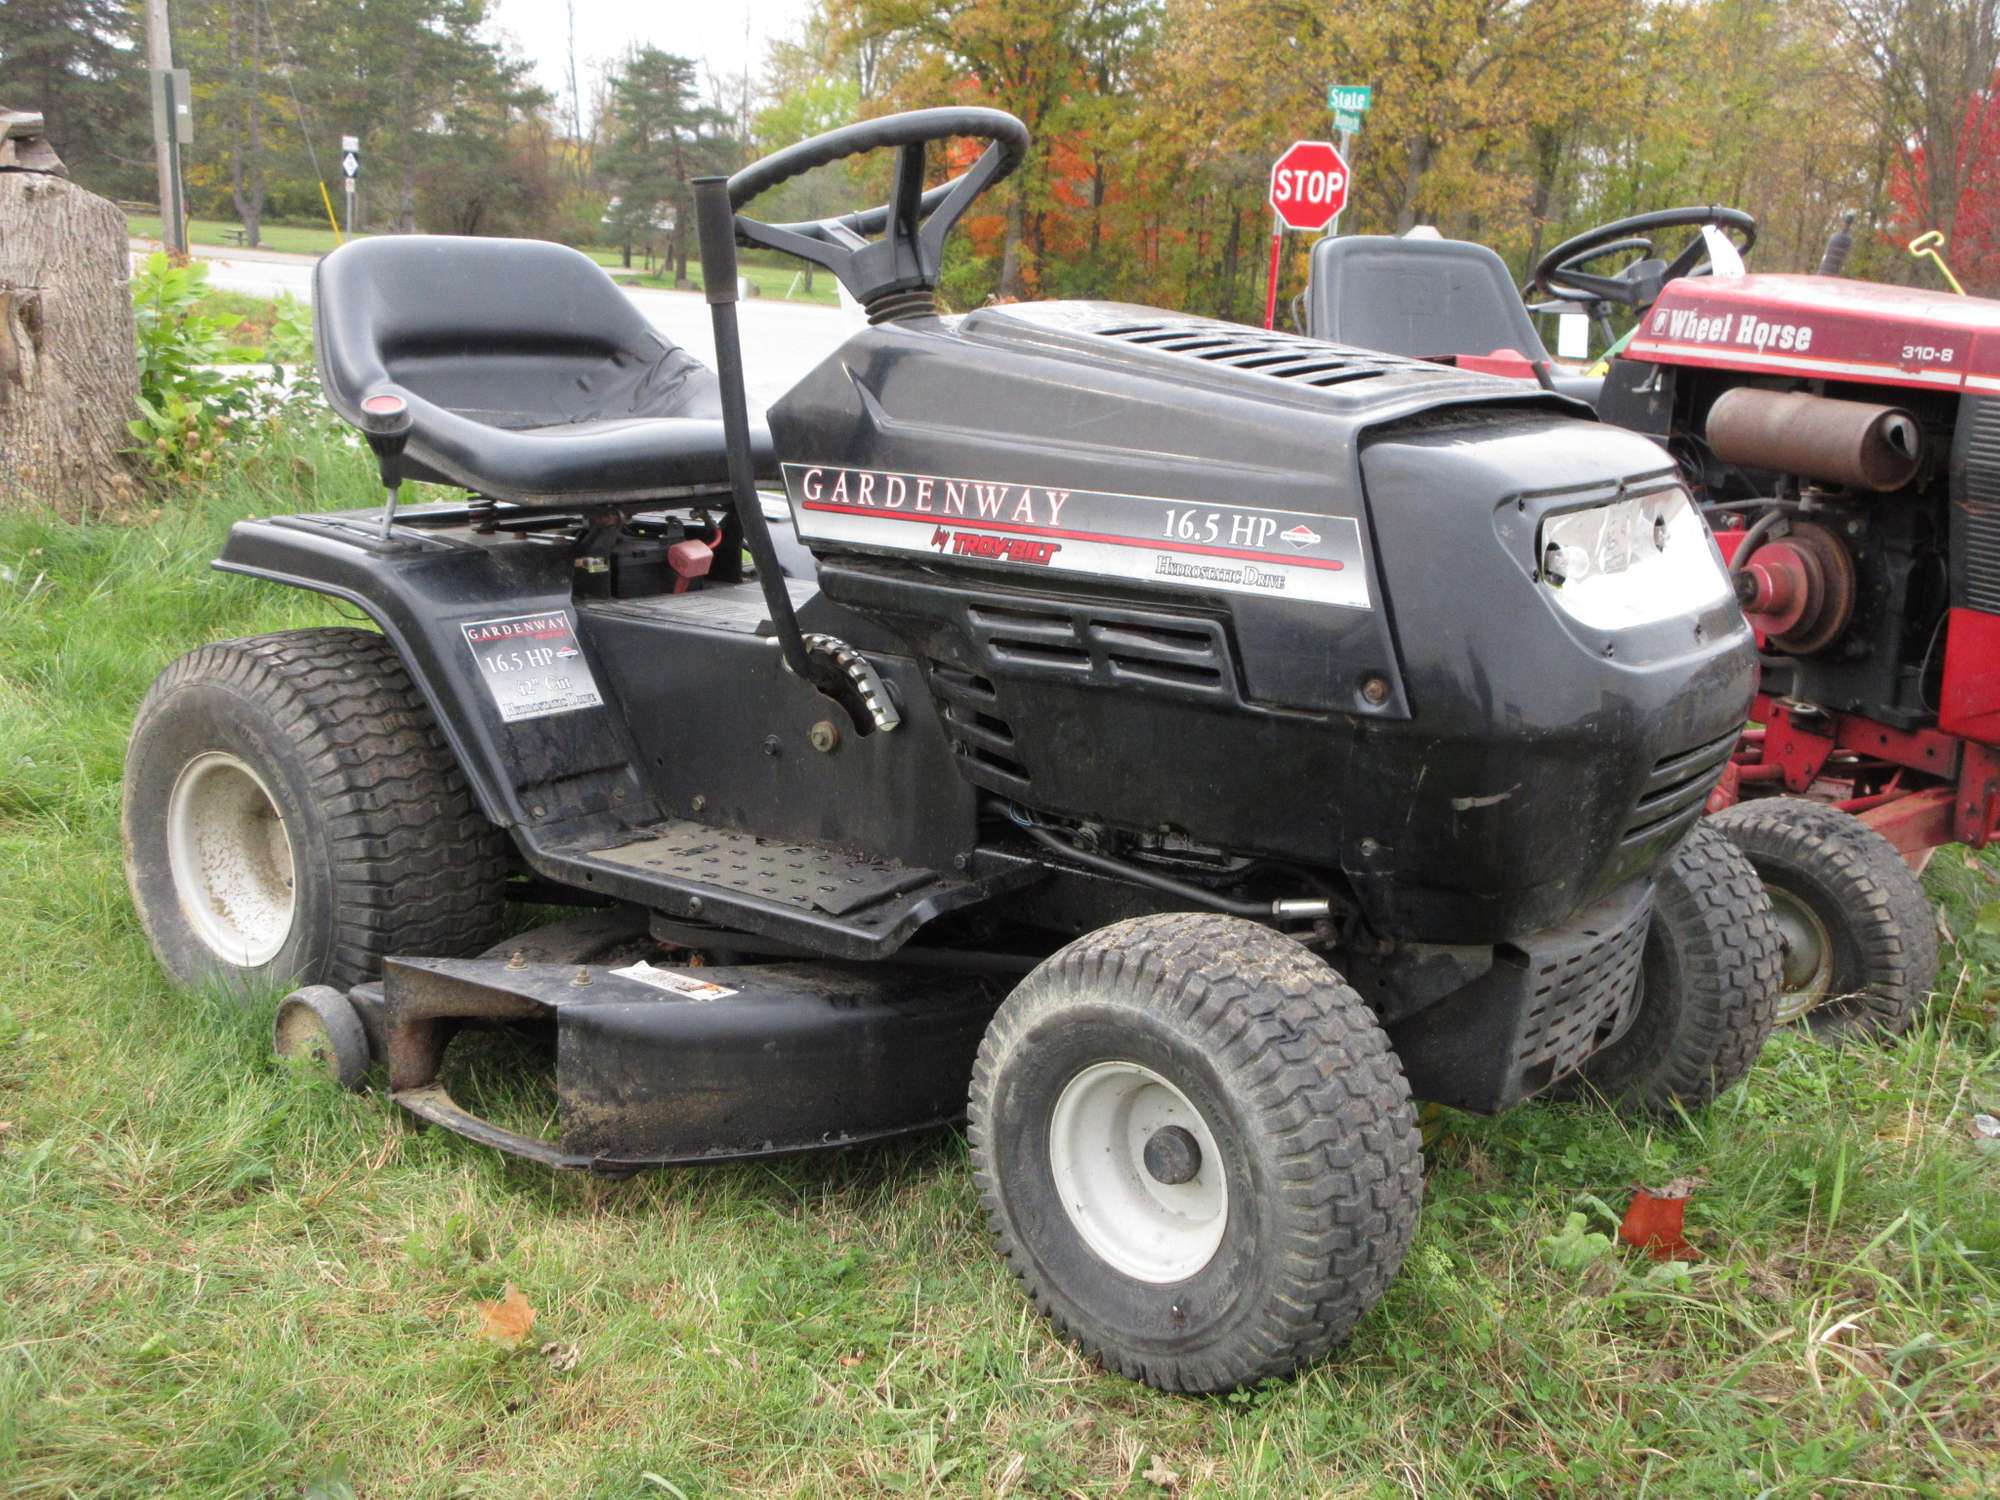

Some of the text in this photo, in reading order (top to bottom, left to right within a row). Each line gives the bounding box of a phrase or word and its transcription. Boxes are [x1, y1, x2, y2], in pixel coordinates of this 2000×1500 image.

[1331, 89, 1365, 109] State
[1275, 169, 1344, 204] STOP
[1669, 308, 1812, 351] Wheel Horse
[1902, 346, 1954, 362] 310-8
[803, 469, 1070, 526] GARDENWAY
[1163, 509, 1277, 547] 16.5 HP
[468, 616, 565, 640] GARDENWAY
[486, 647, 553, 673] 16.5 HP
